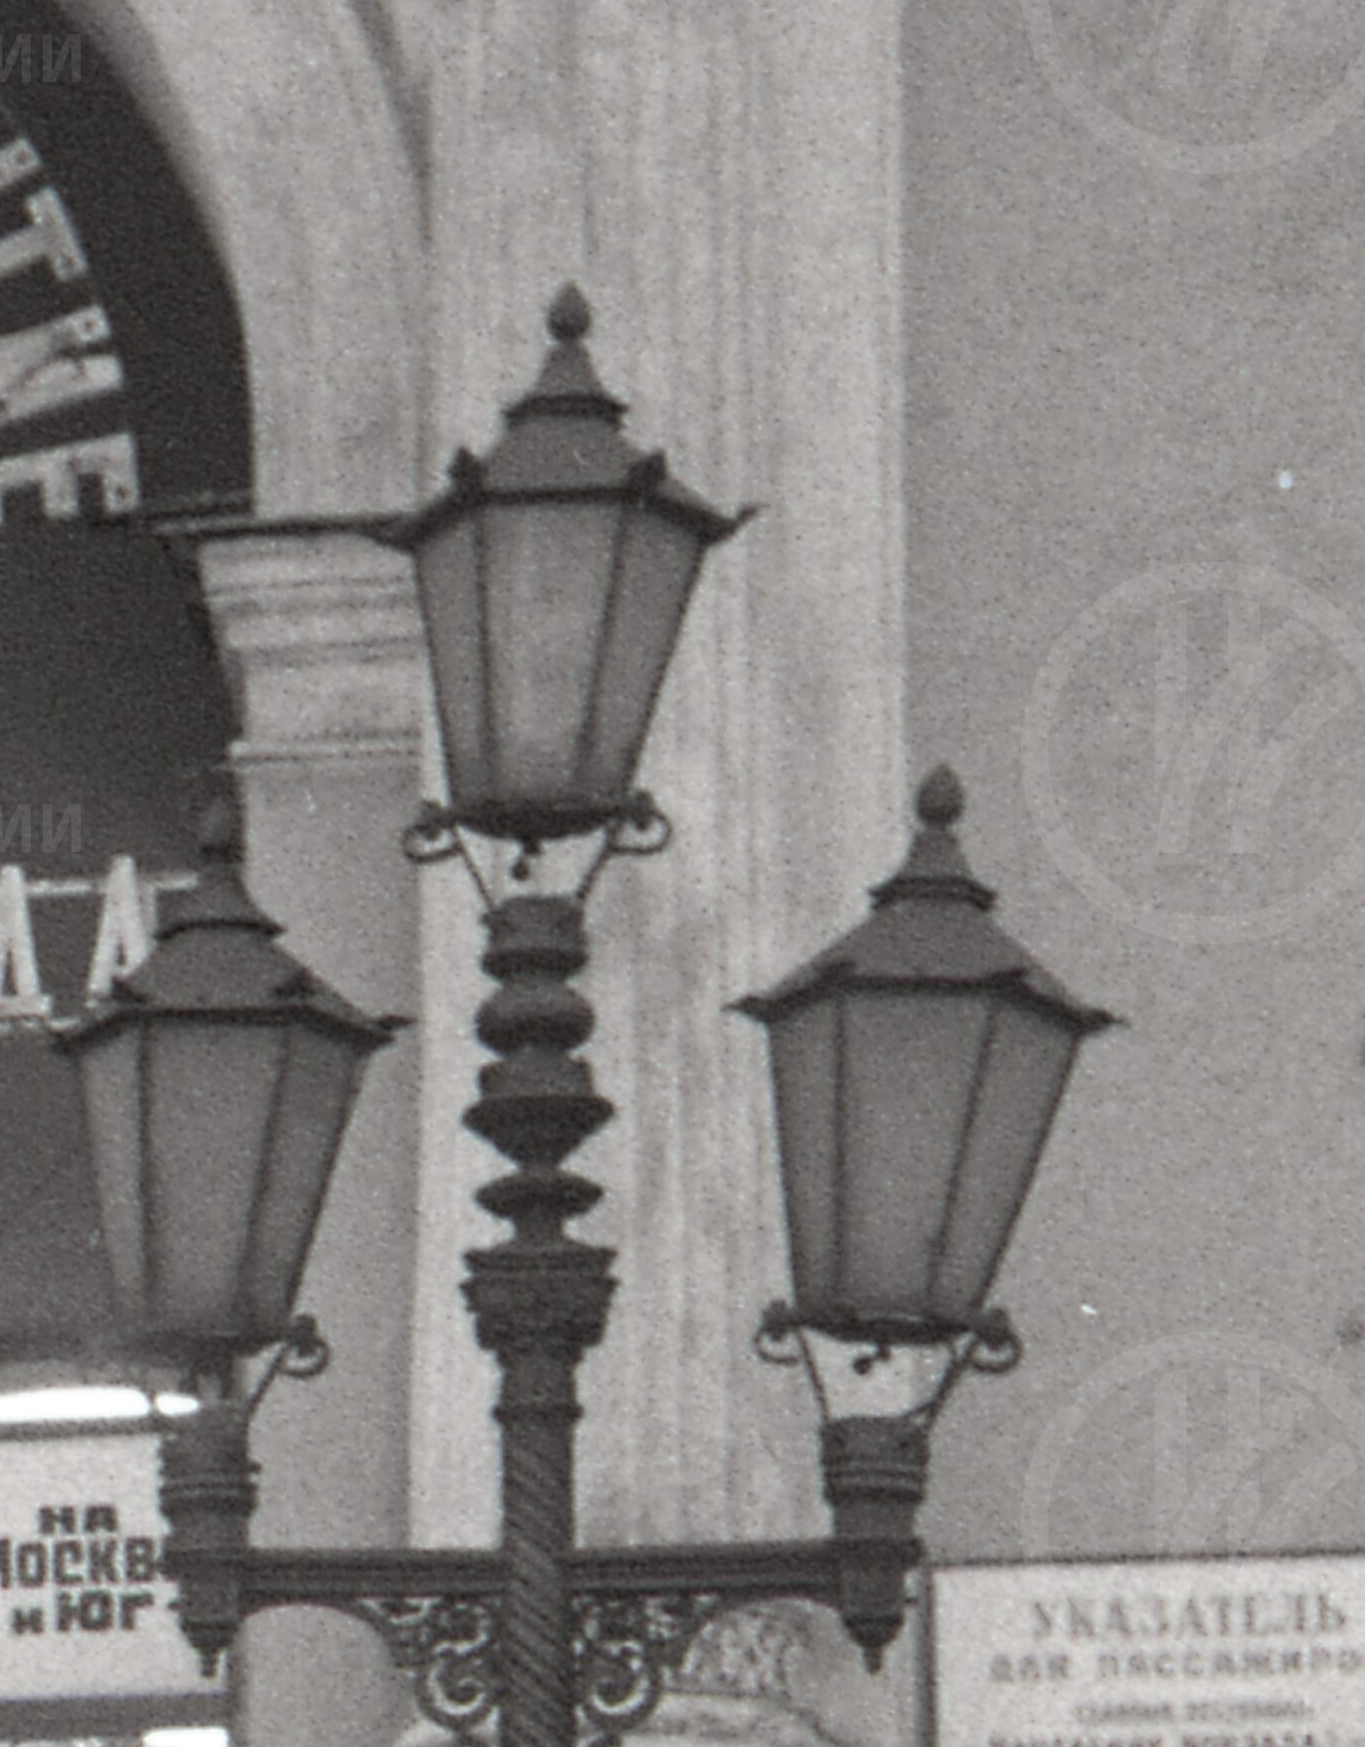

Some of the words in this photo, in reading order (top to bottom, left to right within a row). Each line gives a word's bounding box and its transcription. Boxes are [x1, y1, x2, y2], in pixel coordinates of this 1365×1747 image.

[38, 1505, 117, 1535] НА
[57, 1591, 152, 1631] ЮГ
[1032, 1595, 1347, 1638] УКАЗАТЕЛЬ
